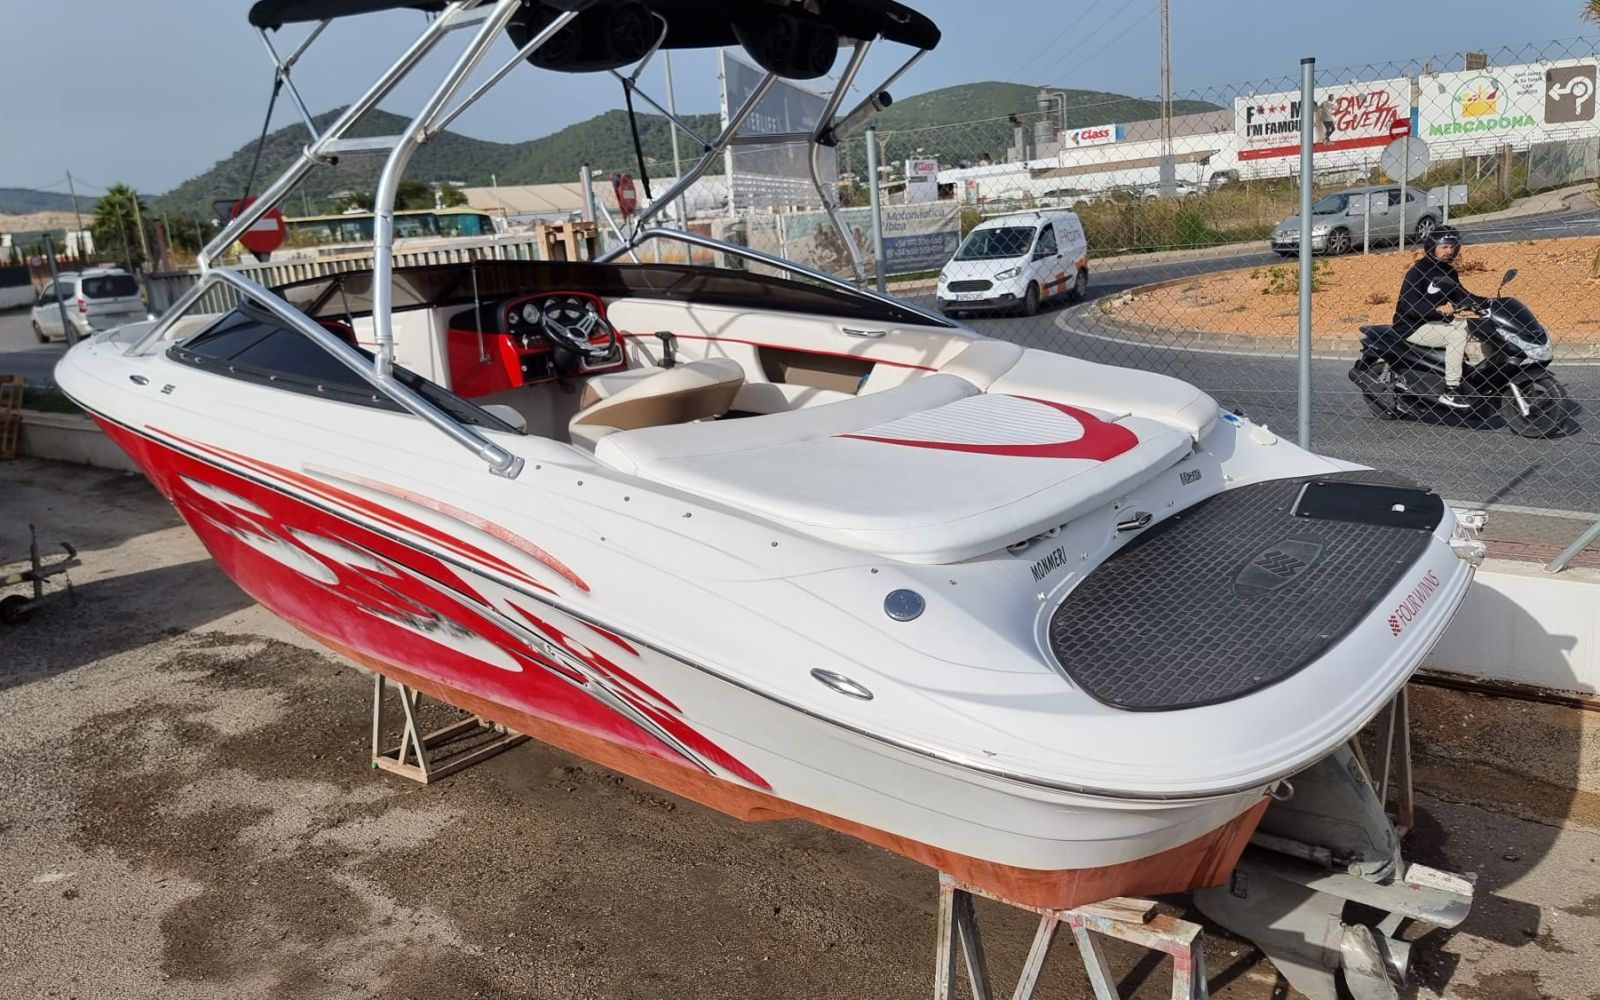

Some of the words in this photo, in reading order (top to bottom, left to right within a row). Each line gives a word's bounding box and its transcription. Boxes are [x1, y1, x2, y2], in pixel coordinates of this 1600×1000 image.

[1331, 90, 1390, 117] DAVID
[1246, 123, 1263, 137] I'M
[1264, 118, 1302, 135] FAMOU
[1336, 104, 1400, 132] GUETTA
[1428, 114, 1536, 137] MERCADONA
[1080, 127, 1111, 141] Class
[1030, 545, 1067, 583] MONMERI
[1395, 594, 1422, 627] FOUR
[1412, 569, 1440, 605] WINNS
